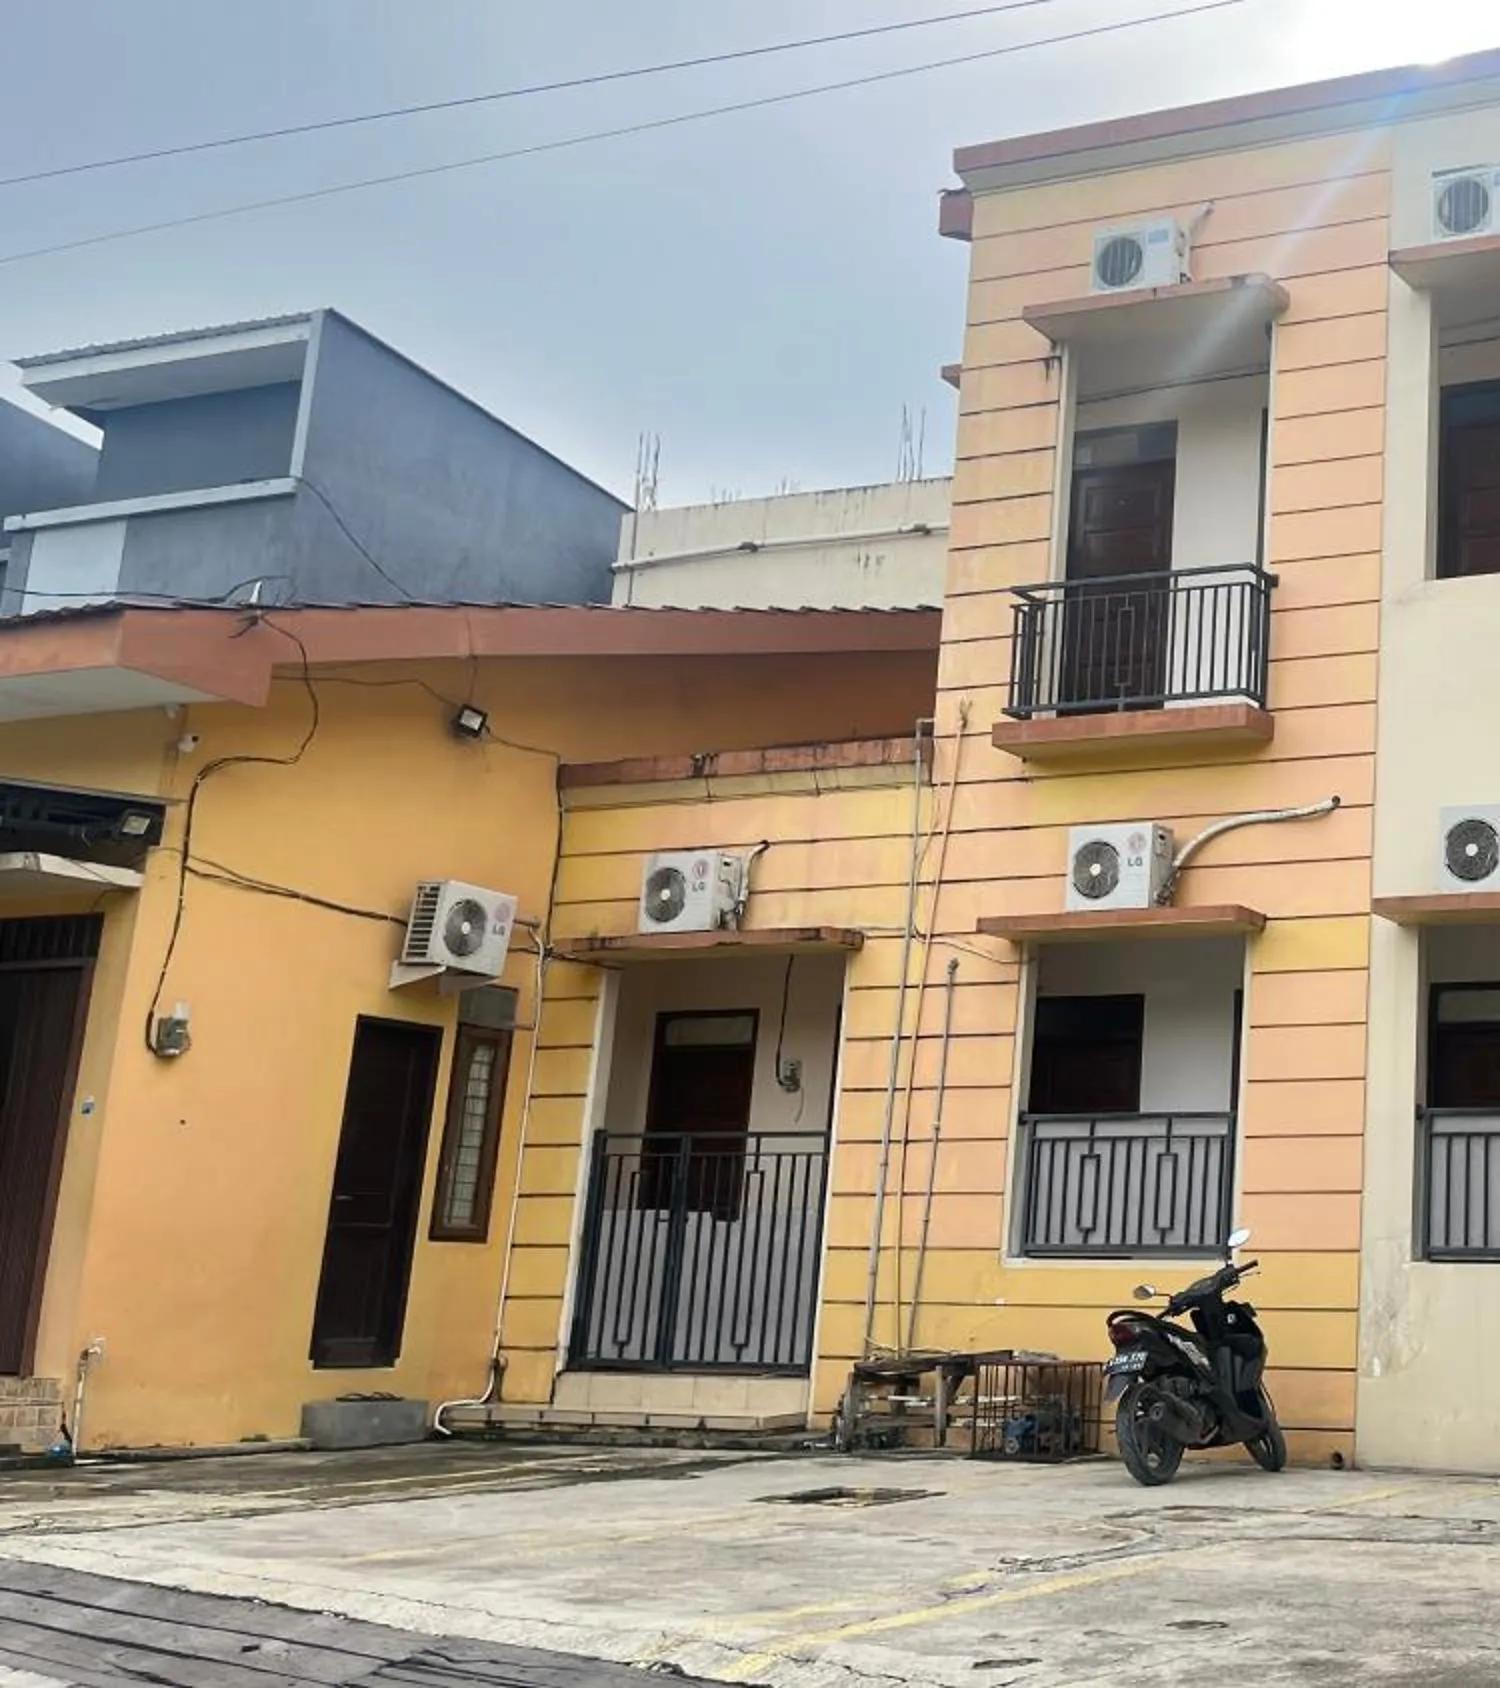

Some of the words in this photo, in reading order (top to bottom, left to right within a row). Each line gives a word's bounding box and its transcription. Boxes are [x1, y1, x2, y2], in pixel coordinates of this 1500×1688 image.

[1127, 857, 1143, 867] LG
[691, 881, 705, 893] LG
[492, 924, 505, 936] LG
